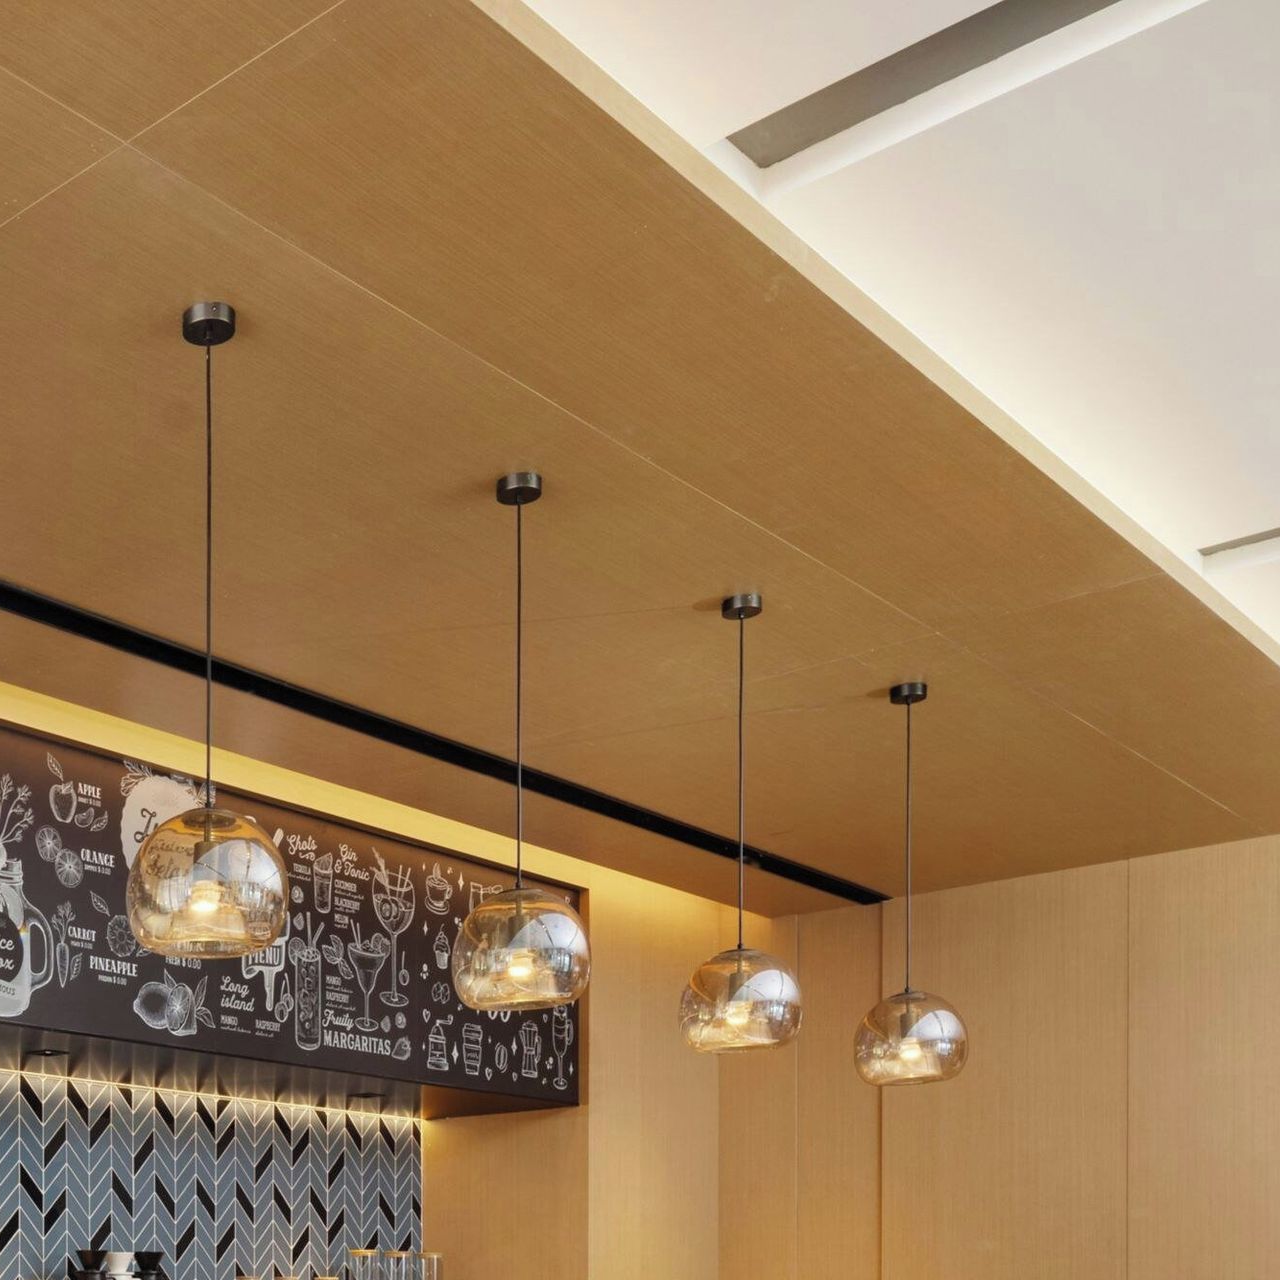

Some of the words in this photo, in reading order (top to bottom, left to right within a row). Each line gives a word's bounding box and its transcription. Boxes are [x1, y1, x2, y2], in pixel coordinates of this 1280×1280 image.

[77, 782, 102, 799] APPLE
[286, 835, 318, 855] Shots
[339, 844, 358, 861] Gin
[81, 848, 115, 868] ORANGE
[334, 859, 343, 873] &
[344, 861, 370, 880] Tonic
[68, 926, 96, 942] CARROT
[89, 955, 138, 977] PINEAPPLE
[248, 947, 280, 965] MENU
[221, 976, 250, 997] Long
[221, 993, 254, 1012] island
[322, 1009, 354, 1031] Fruity
[323, 1030, 391, 1056] MARGARITAS
